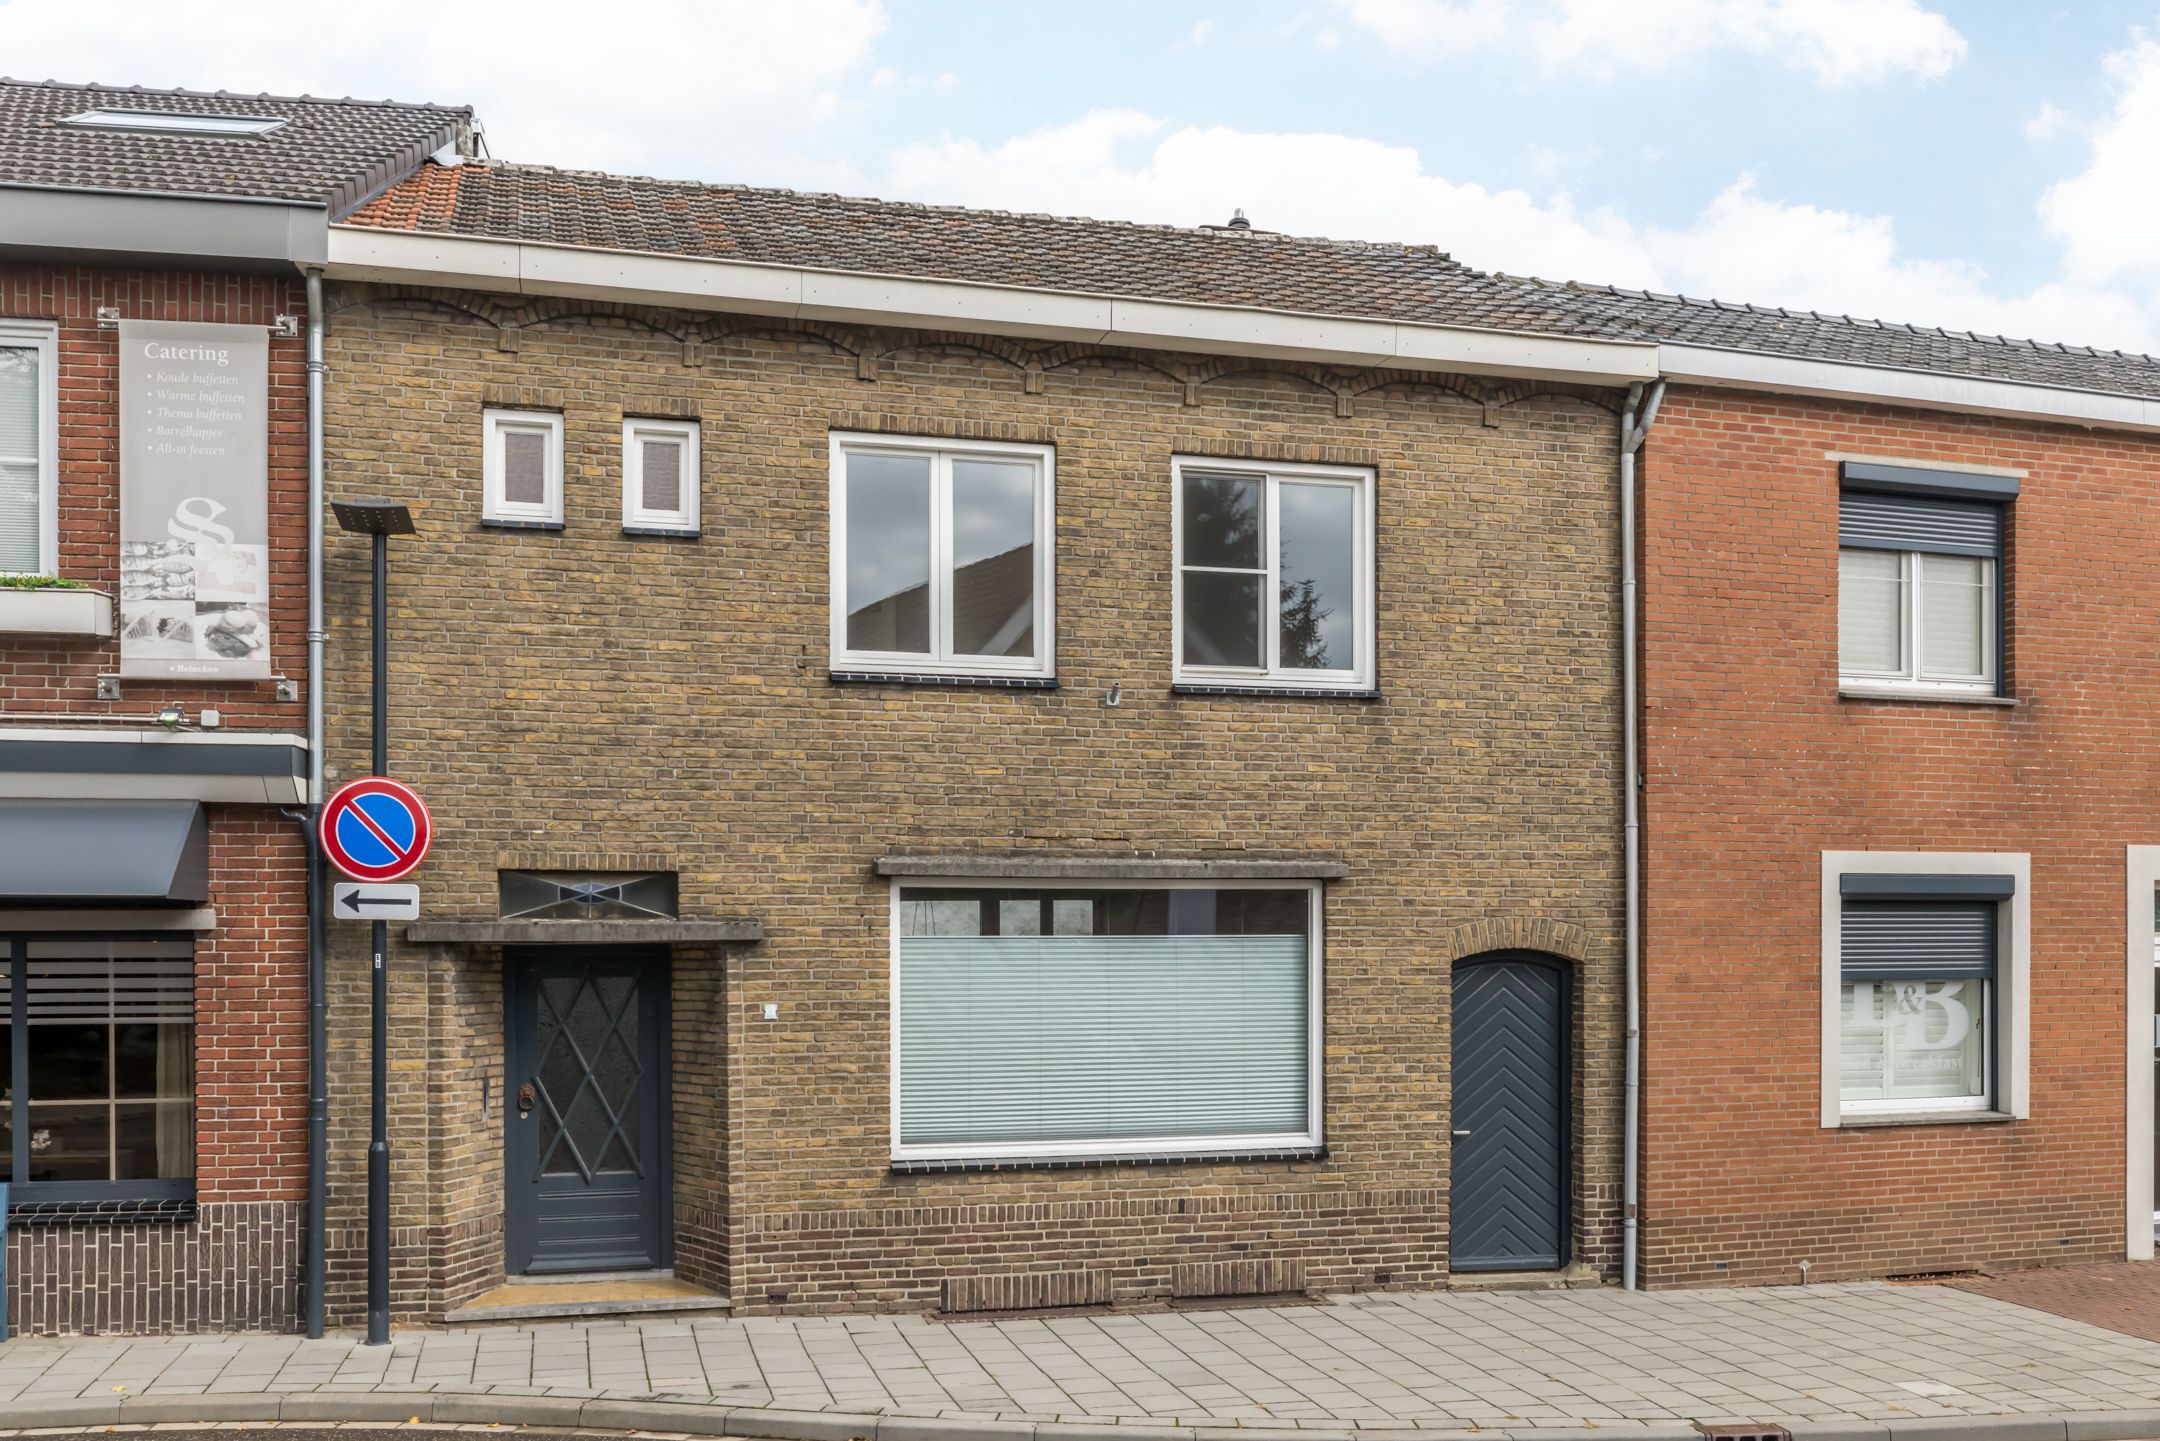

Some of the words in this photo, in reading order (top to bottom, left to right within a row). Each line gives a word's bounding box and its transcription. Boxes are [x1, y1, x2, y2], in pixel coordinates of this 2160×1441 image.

[144, 342, 229, 366] Catering
[156, 371, 189, 383] Koude
[193, 372, 239, 387] buffetten
[156, 389, 196, 401] Warme
[199, 390, 245, 405] buffetten
[156, 407, 192, 419] Thema
[196, 407, 242, 422] buffetten
[156, 424, 222, 440] Borrelhapjes
[156, 442, 187, 454] All-in
[187, 444, 225, 458] feesten
[177, 664, 219, 673] Heineken
